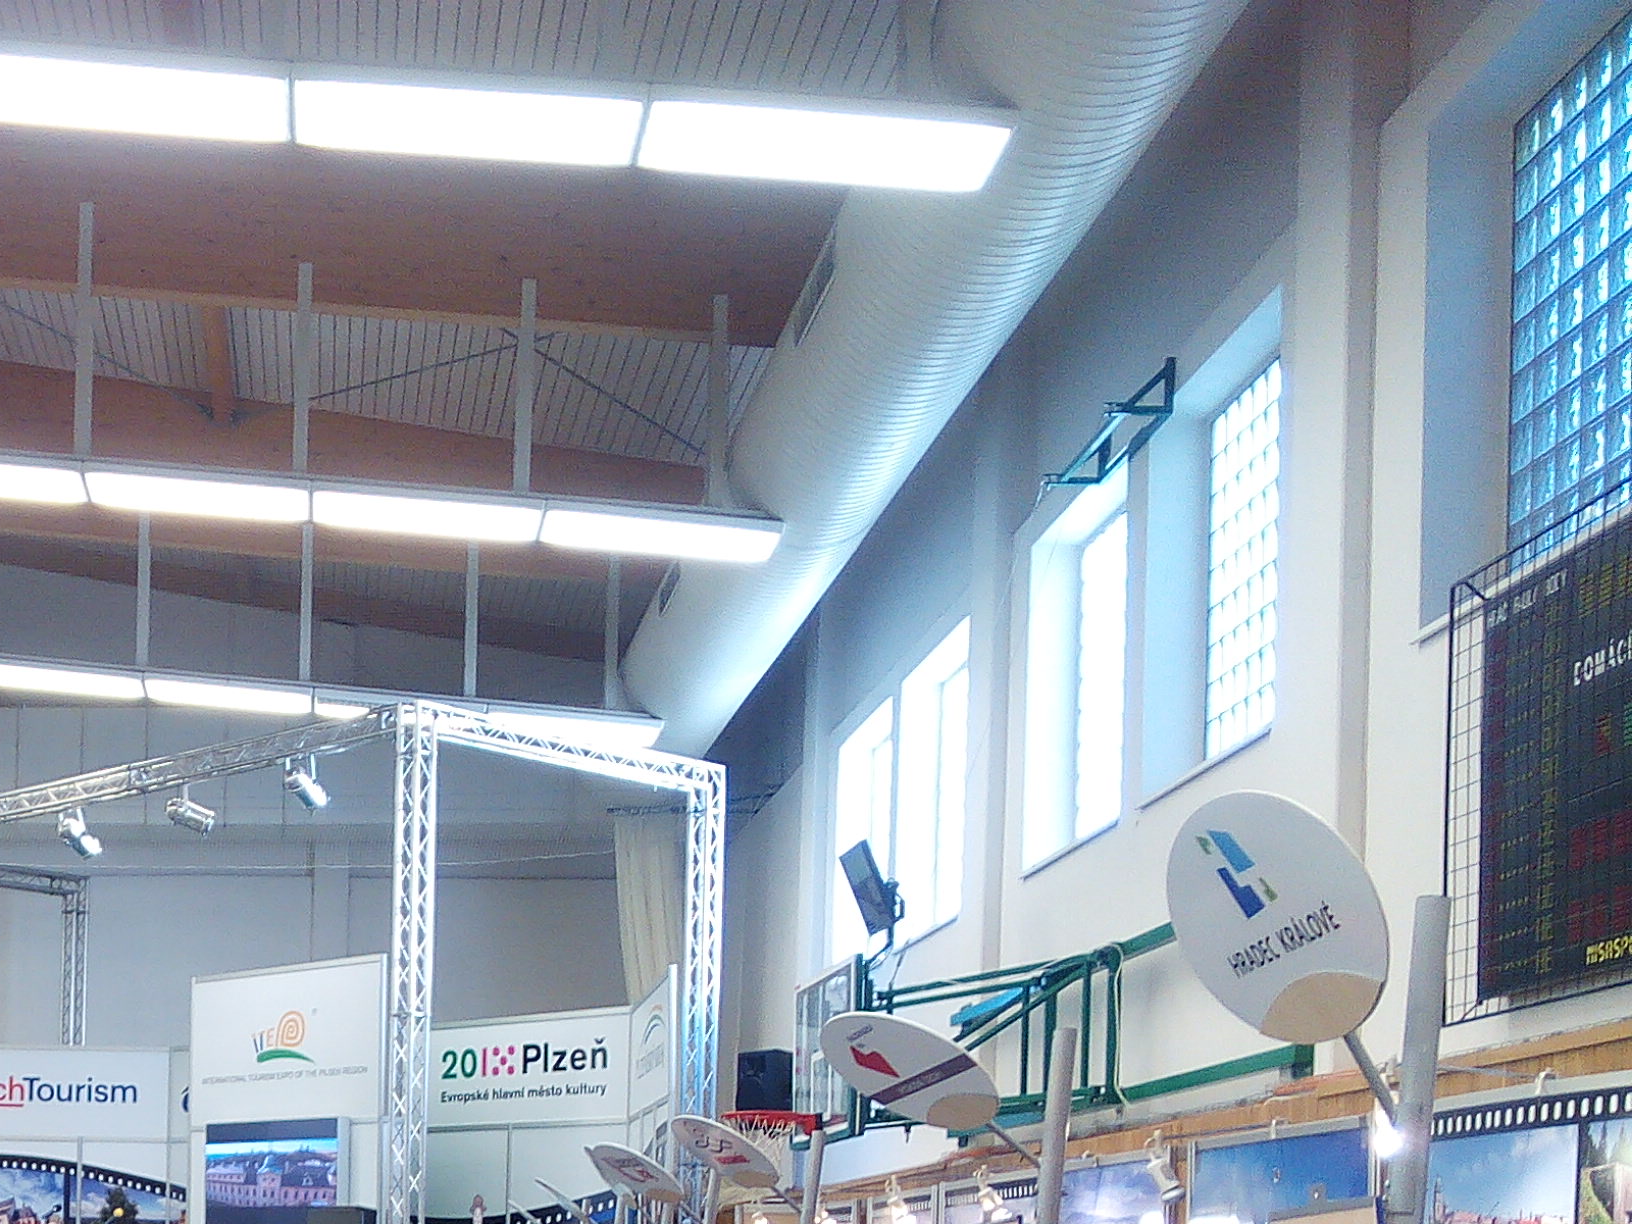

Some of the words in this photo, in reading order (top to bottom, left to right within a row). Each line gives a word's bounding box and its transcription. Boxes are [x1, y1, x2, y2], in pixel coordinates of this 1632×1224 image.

[1227, 936, 1280, 979] HRADEC
[1275, 897, 1340, 953] KRÁLOVÉ
[522, 1037, 608, 1075] Plzeň
[440, 1089, 490, 1104] Evropské
[492, 1086, 525, 1101] hlavní
[527, 1086, 563, 1099] město
[565, 1083, 607, 1098] kultury
